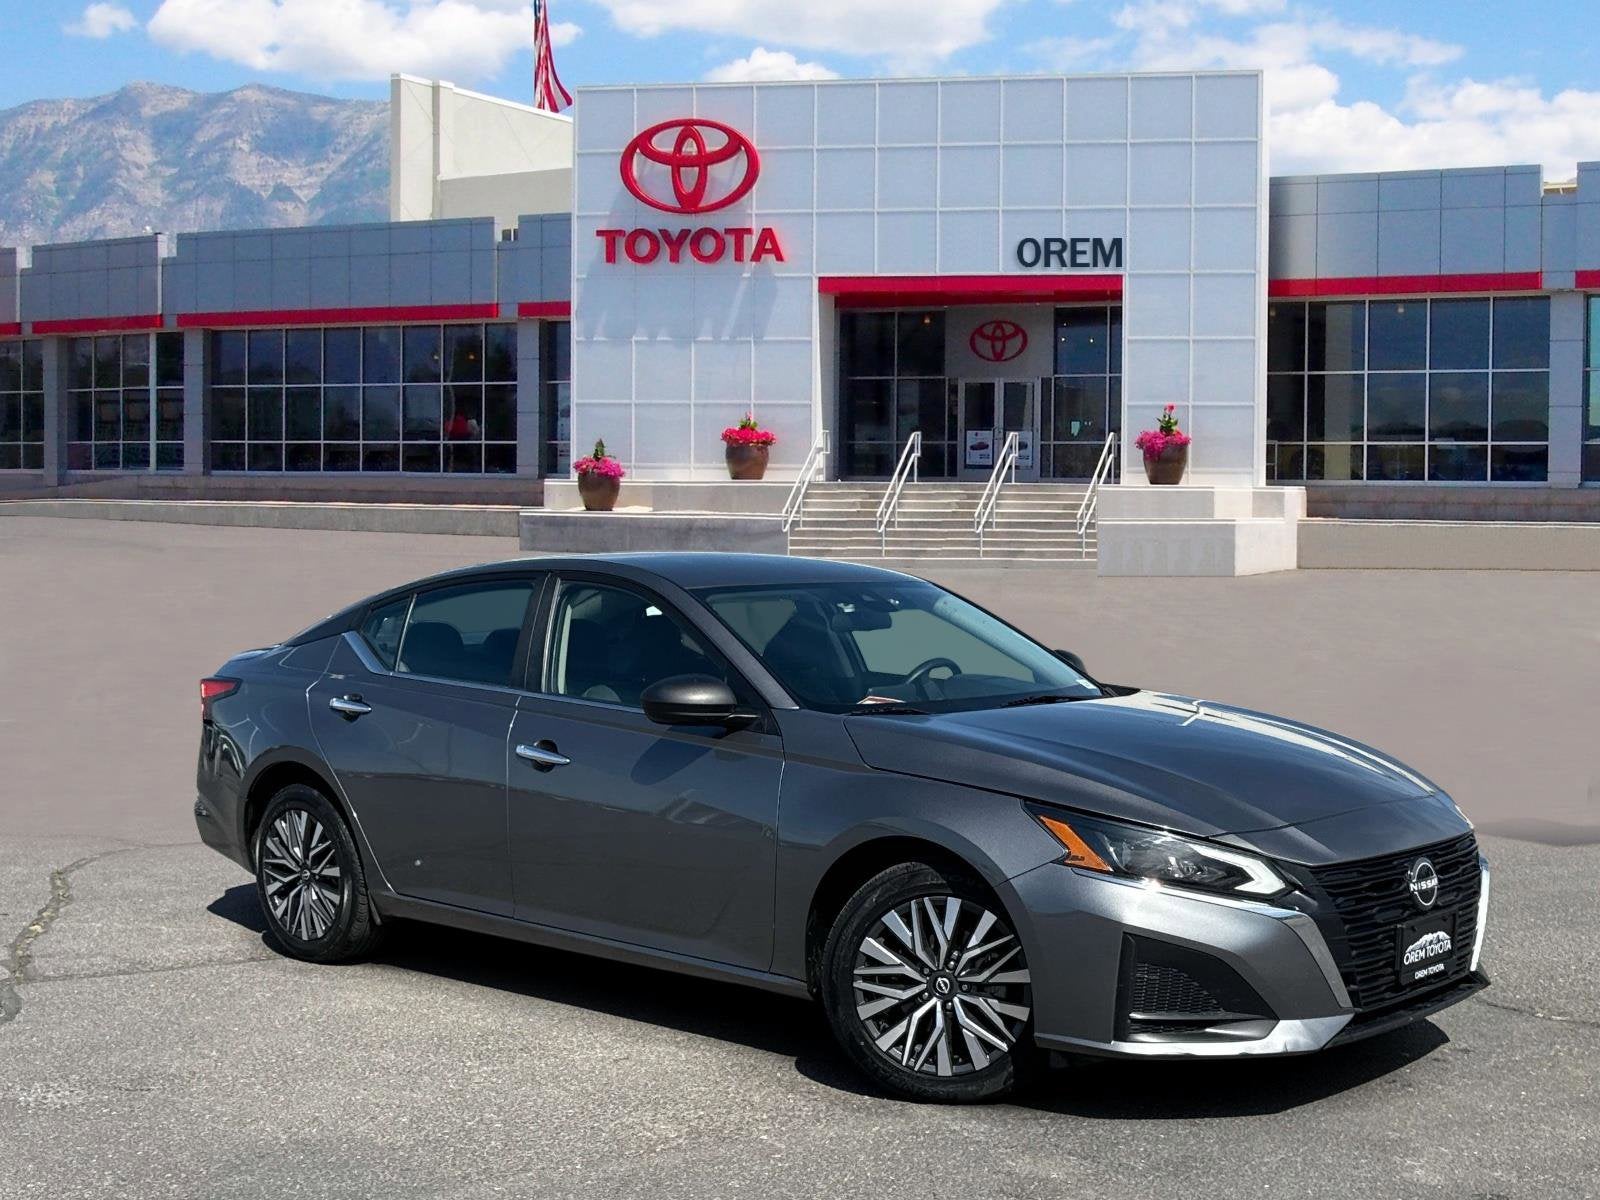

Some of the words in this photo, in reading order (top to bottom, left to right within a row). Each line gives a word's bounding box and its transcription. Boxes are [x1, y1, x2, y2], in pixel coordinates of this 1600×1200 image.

[596, 228, 785, 264] TOYOTA
[1016, 237, 1123, 268] OREM
[1403, 948, 1426, 965] OREM
[1426, 940, 1452, 958] TOYOTA
[1415, 969, 1428, 979] OREM
[1428, 963, 1445, 975] TOYOTA
